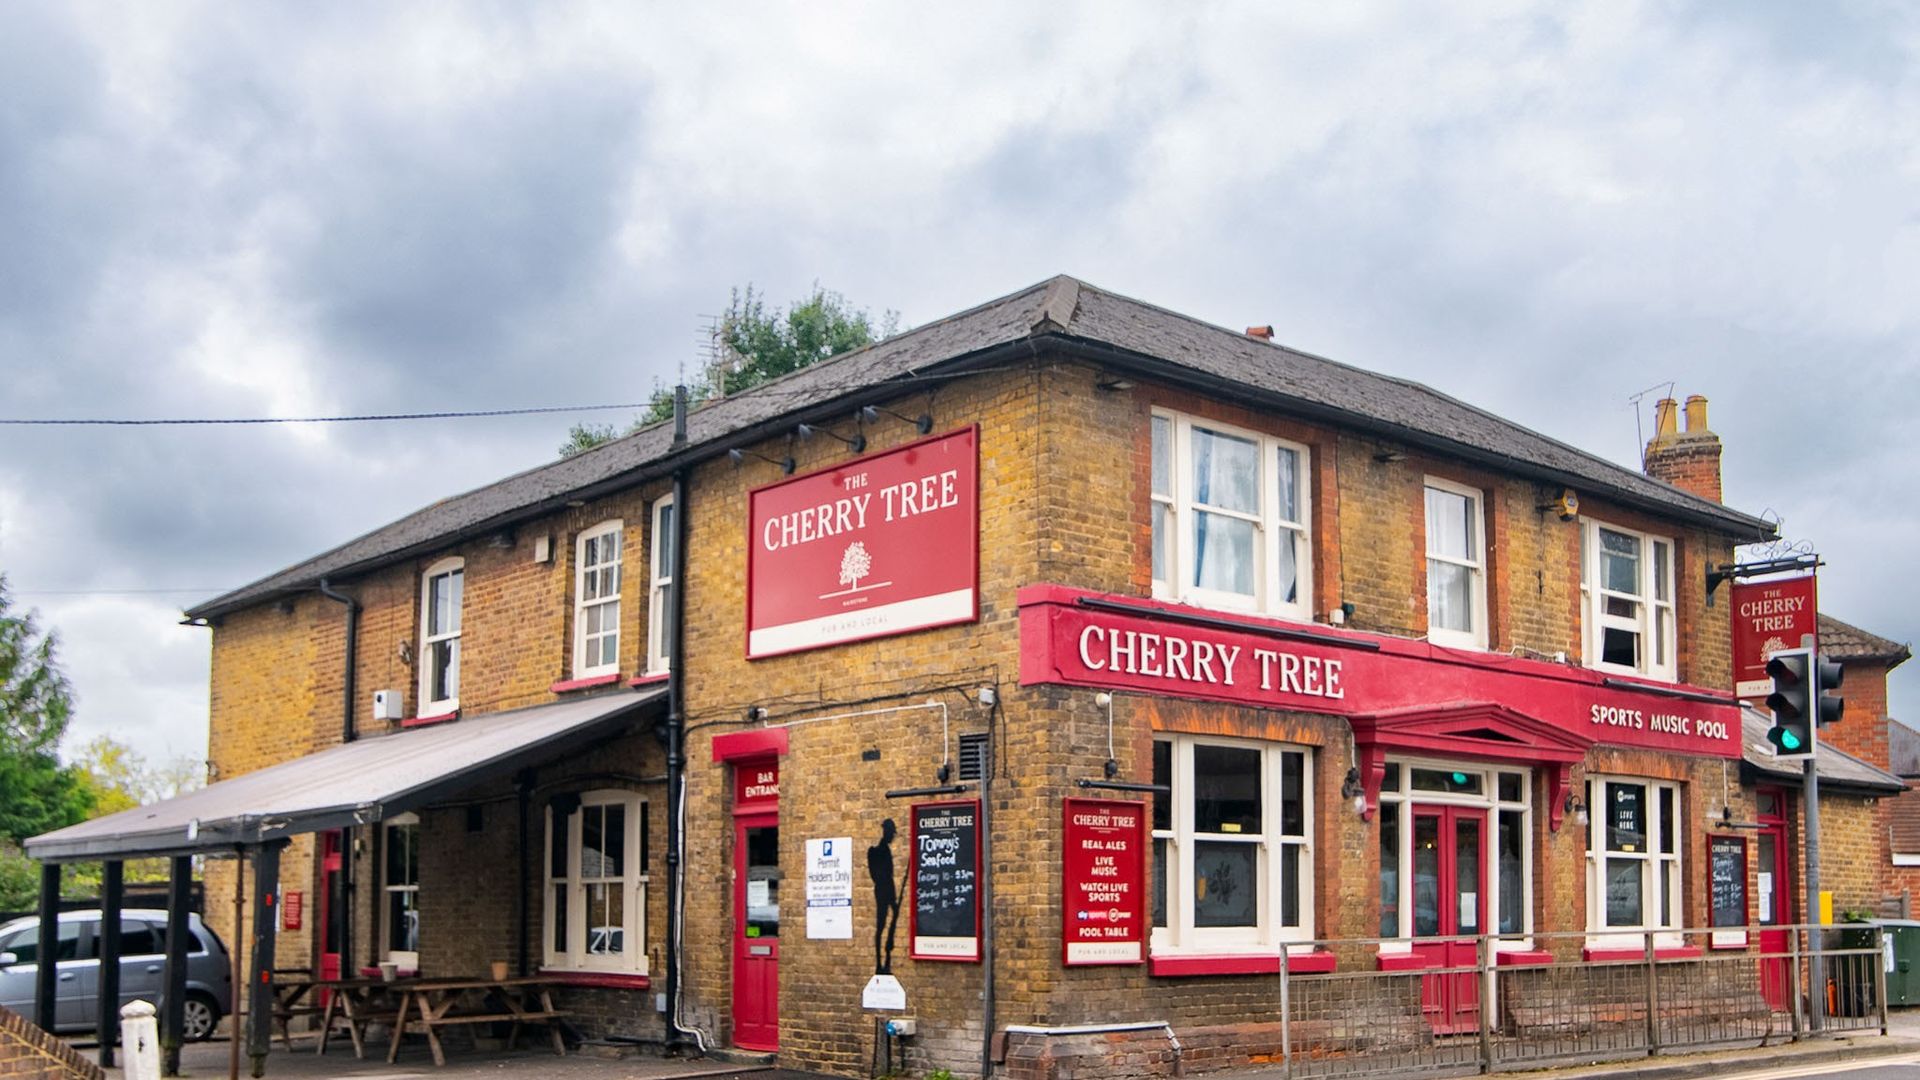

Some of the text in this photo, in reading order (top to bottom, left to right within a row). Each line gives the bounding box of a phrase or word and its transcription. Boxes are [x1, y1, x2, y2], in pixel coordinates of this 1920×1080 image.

[843, 473, 868, 491] THE
[763, 469, 959, 552] CHERRY TREE
[1763, 589, 1782, 599] THE
[1740, 596, 1805, 617] CHERRY
[1752, 615, 1795, 633] TREE
[1079, 625, 1345, 699] CHERRY TREE
[1591, 704, 1729, 740] SPORTS MUSIC POOL
[757, 771, 775, 784] BAR
[1073, 814, 1136, 828] CHERRY TREE
[1620, 810, 1634, 819] LIVE
[919, 815, 973, 828] CHERRY TREE
[917, 833, 960, 854] Tommy's
[1082, 840, 1126, 850] REAL ALES
[818, 858, 840, 868] Permit
[920, 852, 956, 868] Seafood
[1095, 856, 1114, 866] LIVE
[808, 871, 850, 884] Holders Only
[1091, 866, 1118, 876] MUSIC
[1080, 882, 1129, 893] WATCH LIVE
[832, 898, 849, 906] LAND
[1088, 892, 1120, 902] SPORTS
[1079, 927, 1129, 937] POOL TABLE
